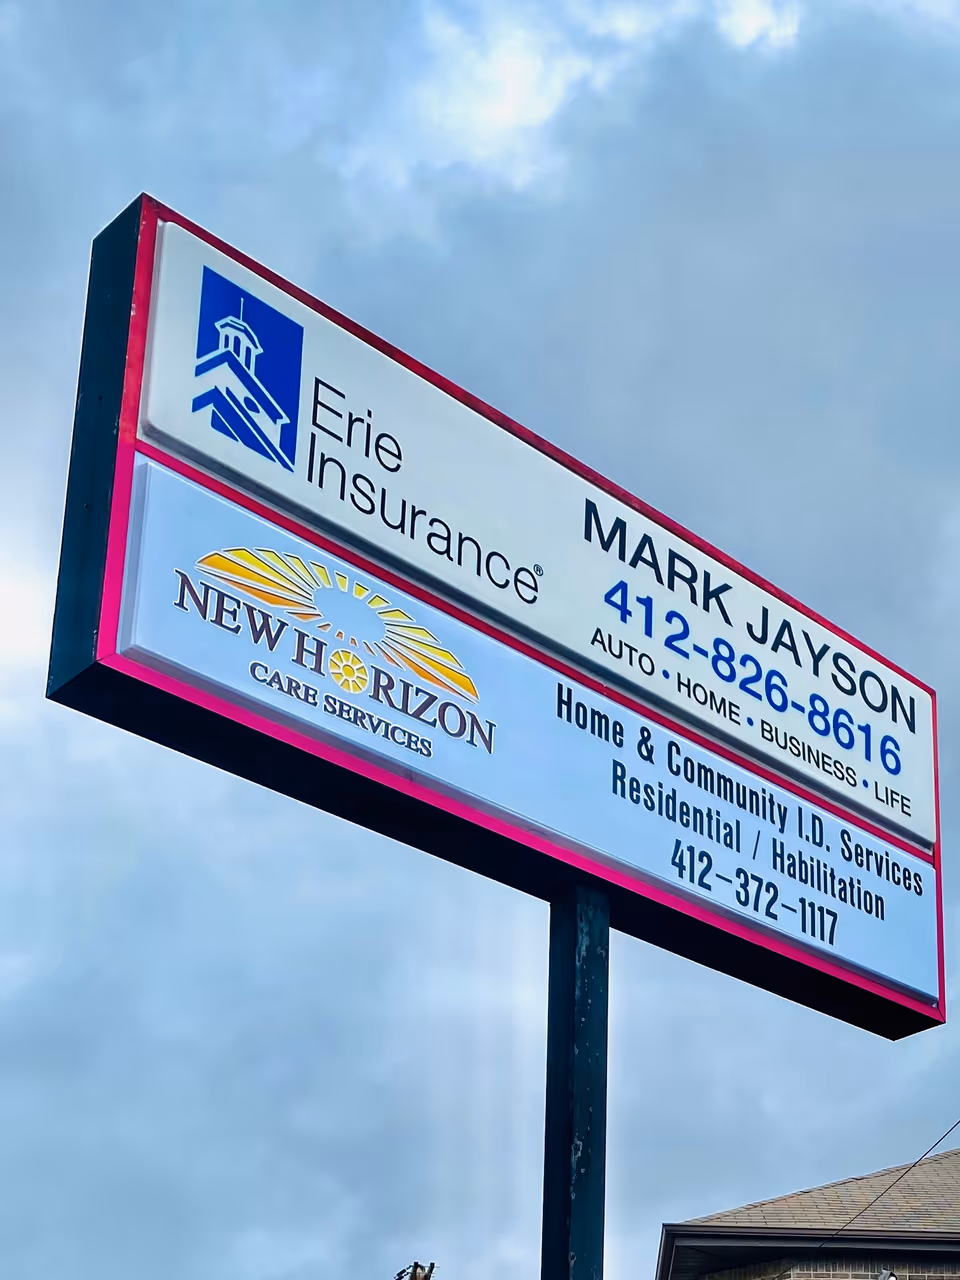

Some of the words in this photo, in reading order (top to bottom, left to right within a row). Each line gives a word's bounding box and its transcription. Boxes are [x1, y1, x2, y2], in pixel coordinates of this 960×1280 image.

[310, 377, 402, 473] Erie
[174, 568, 290, 653] NEW
[291, 622, 497, 755] HORIZON
[249, 661, 319, 708] CARE
[323, 694, 434, 758] SERVICES
[584, 498, 733, 627] MARK
[746, 606, 917, 734] JAYSON
[604, 580, 901, 776] 412-826-8616
[557, 682, 625, 749] Home
[637, 726, 656, 764] &
[667, 740, 788, 829] Community
[798, 808, 831, 853] I.D.
[840, 828, 924, 897] Services
[590, 627, 656, 677] AUTO
[677, 672, 742, 726] HOME
[761, 719, 858, 788] BUSINESS
[874, 780, 912, 817] LIFE
[612, 759, 742, 853] Residential
[772, 837, 885, 921] Habilitation
[671, 838, 838, 945] 412-372-1117
